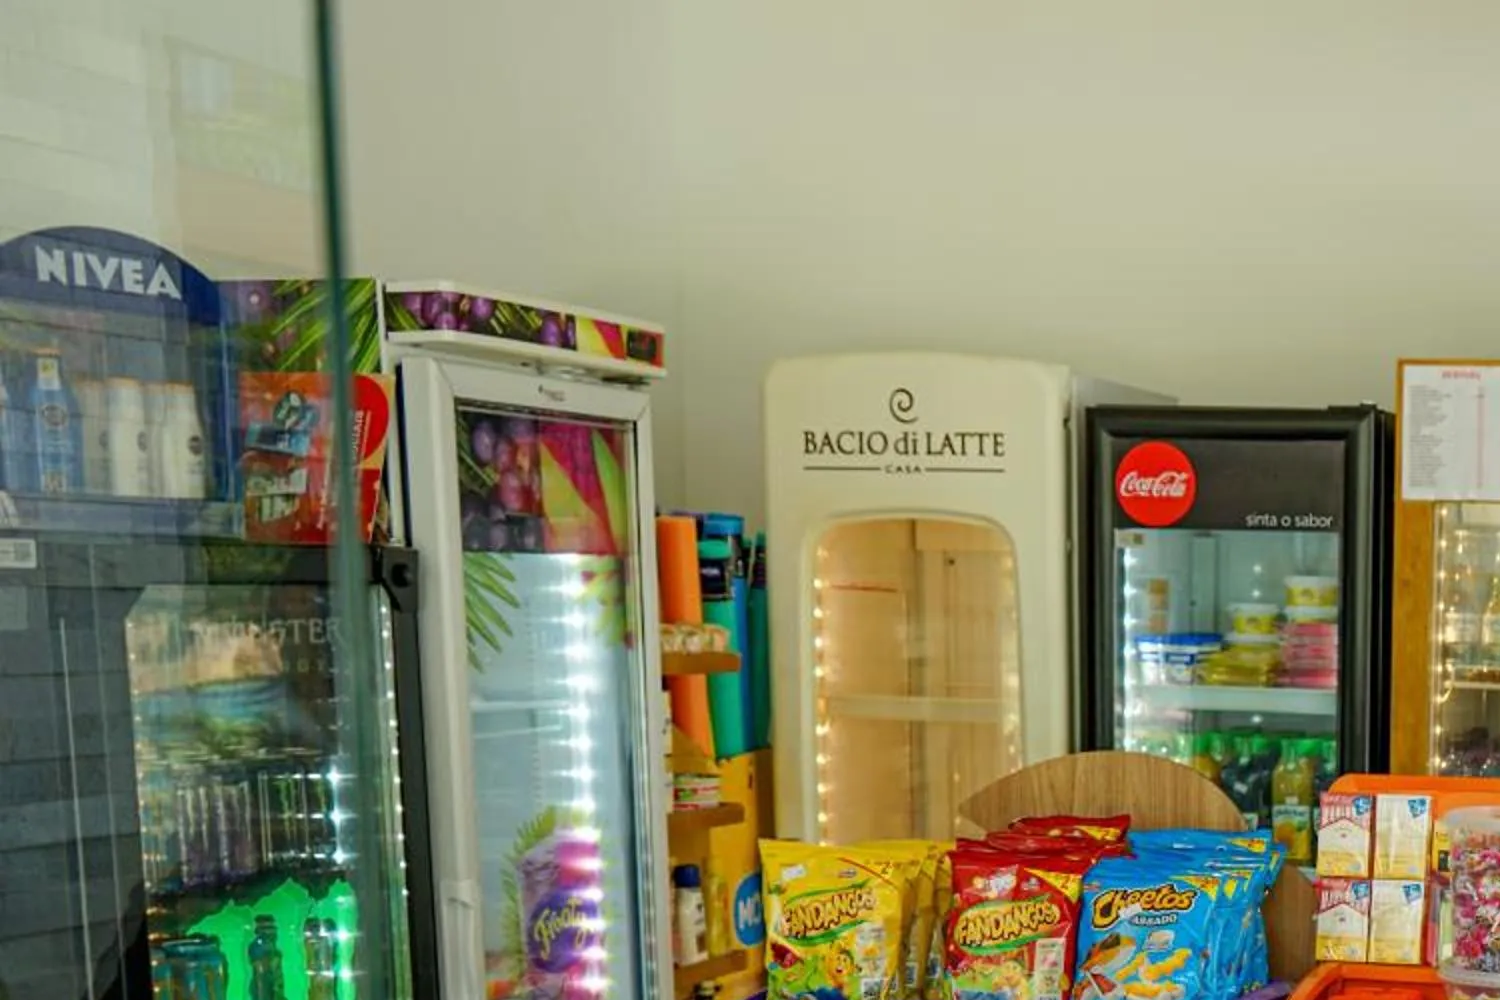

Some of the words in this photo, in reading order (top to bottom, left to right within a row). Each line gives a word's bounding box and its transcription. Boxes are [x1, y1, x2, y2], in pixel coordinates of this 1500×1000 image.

[34, 244, 182, 299] NIVEA
[803, 431, 889, 457] BACIO
[893, 430, 919, 457] di
[924, 432, 1006, 459] LATTE
[884, 464, 922, 475] CASA
[1119, 469, 1190, 499] Coca-Cola
[1245, 511, 1278, 528] sinta
[1280, 516, 1292, 528] o
[1294, 511, 1334, 529] sabor
[782, 886, 877, 939] FANDANGOS
[959, 901, 1057, 947] FANDANGOS
[1091, 882, 1200, 930] Cheetos
